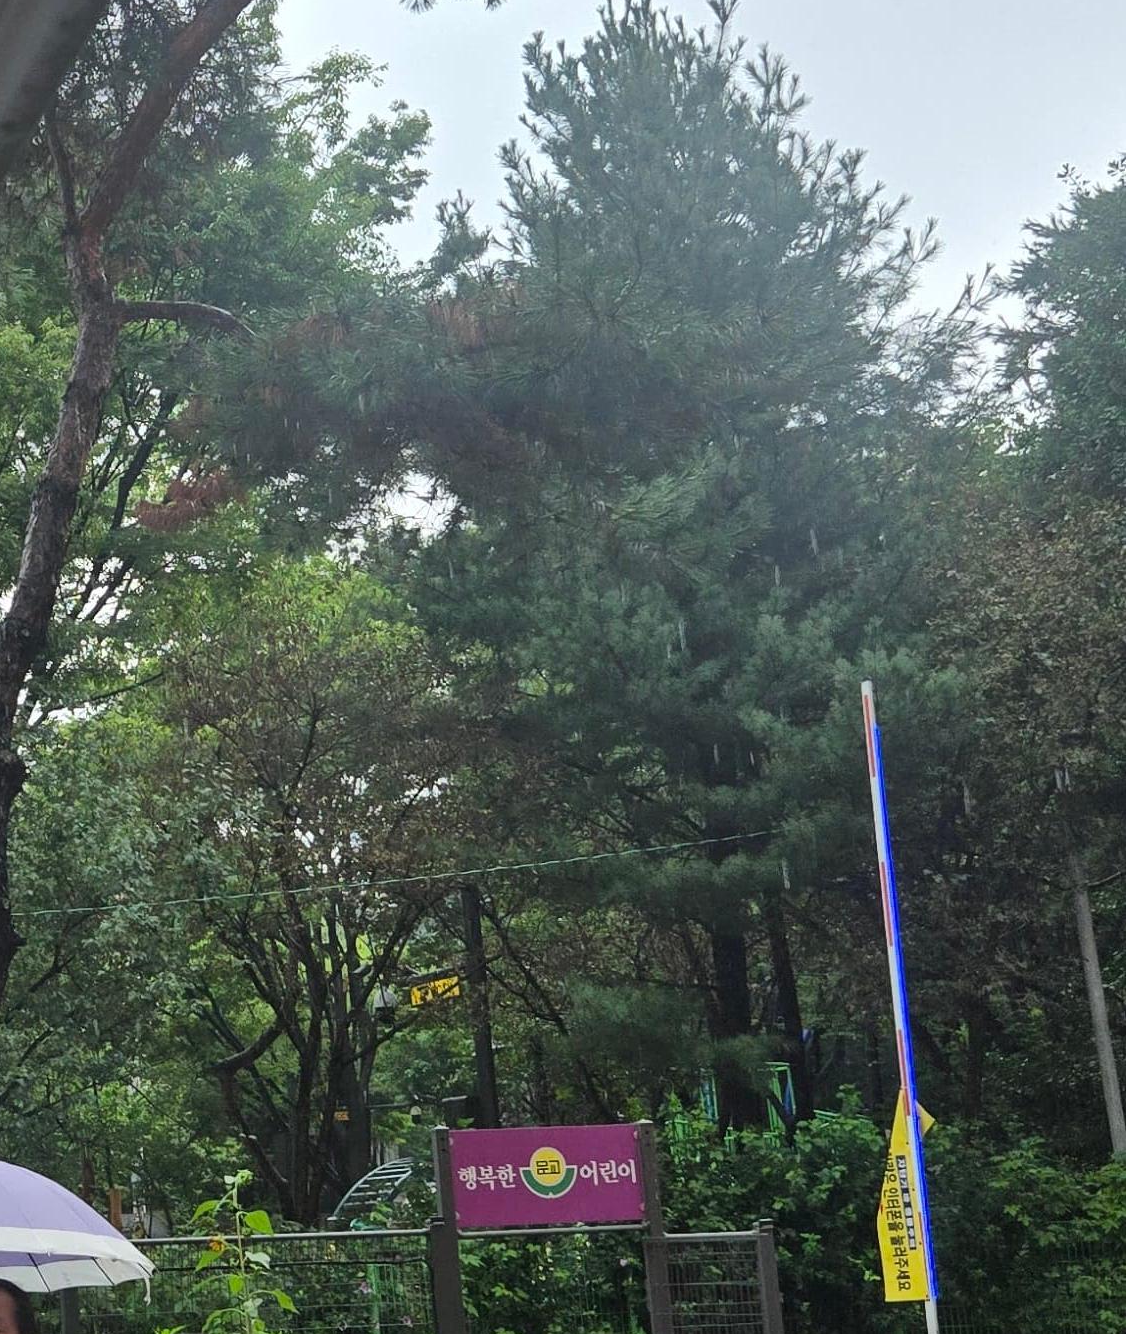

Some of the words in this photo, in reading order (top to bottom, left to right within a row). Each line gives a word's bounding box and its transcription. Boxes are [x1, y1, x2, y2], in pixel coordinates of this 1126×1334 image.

[457, 1164, 516, 1191] 행복한
[580, 1159, 638, 1186] 어린이
[883, 1187, 904, 1232] 인터폰을
[889, 1235, 911, 1291] 눌러주세요
